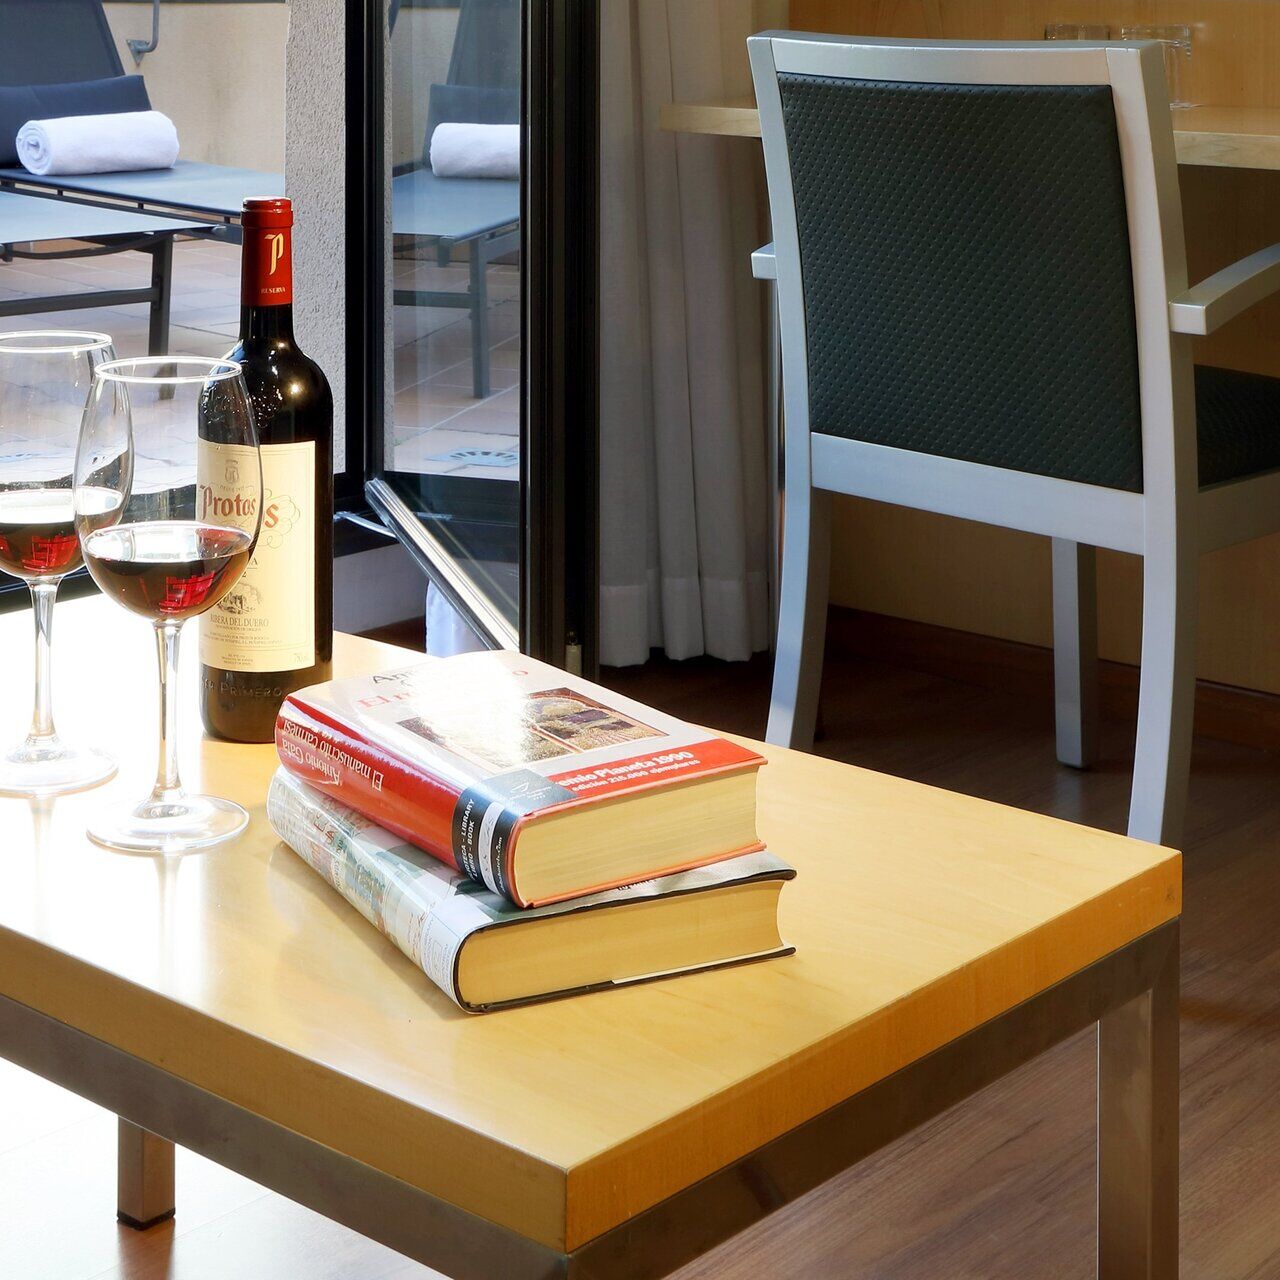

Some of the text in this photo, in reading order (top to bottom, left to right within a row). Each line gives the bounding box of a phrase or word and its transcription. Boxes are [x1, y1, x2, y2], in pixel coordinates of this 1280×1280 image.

[305, 751, 341, 786] Antonio
[593, 759, 658, 777] Planeta
[651, 750, 695, 764] 1990
[371, 770, 385, 792] El
[461, 798, 475, 837] LIBRARY
[467, 820, 475, 846] BOOK
